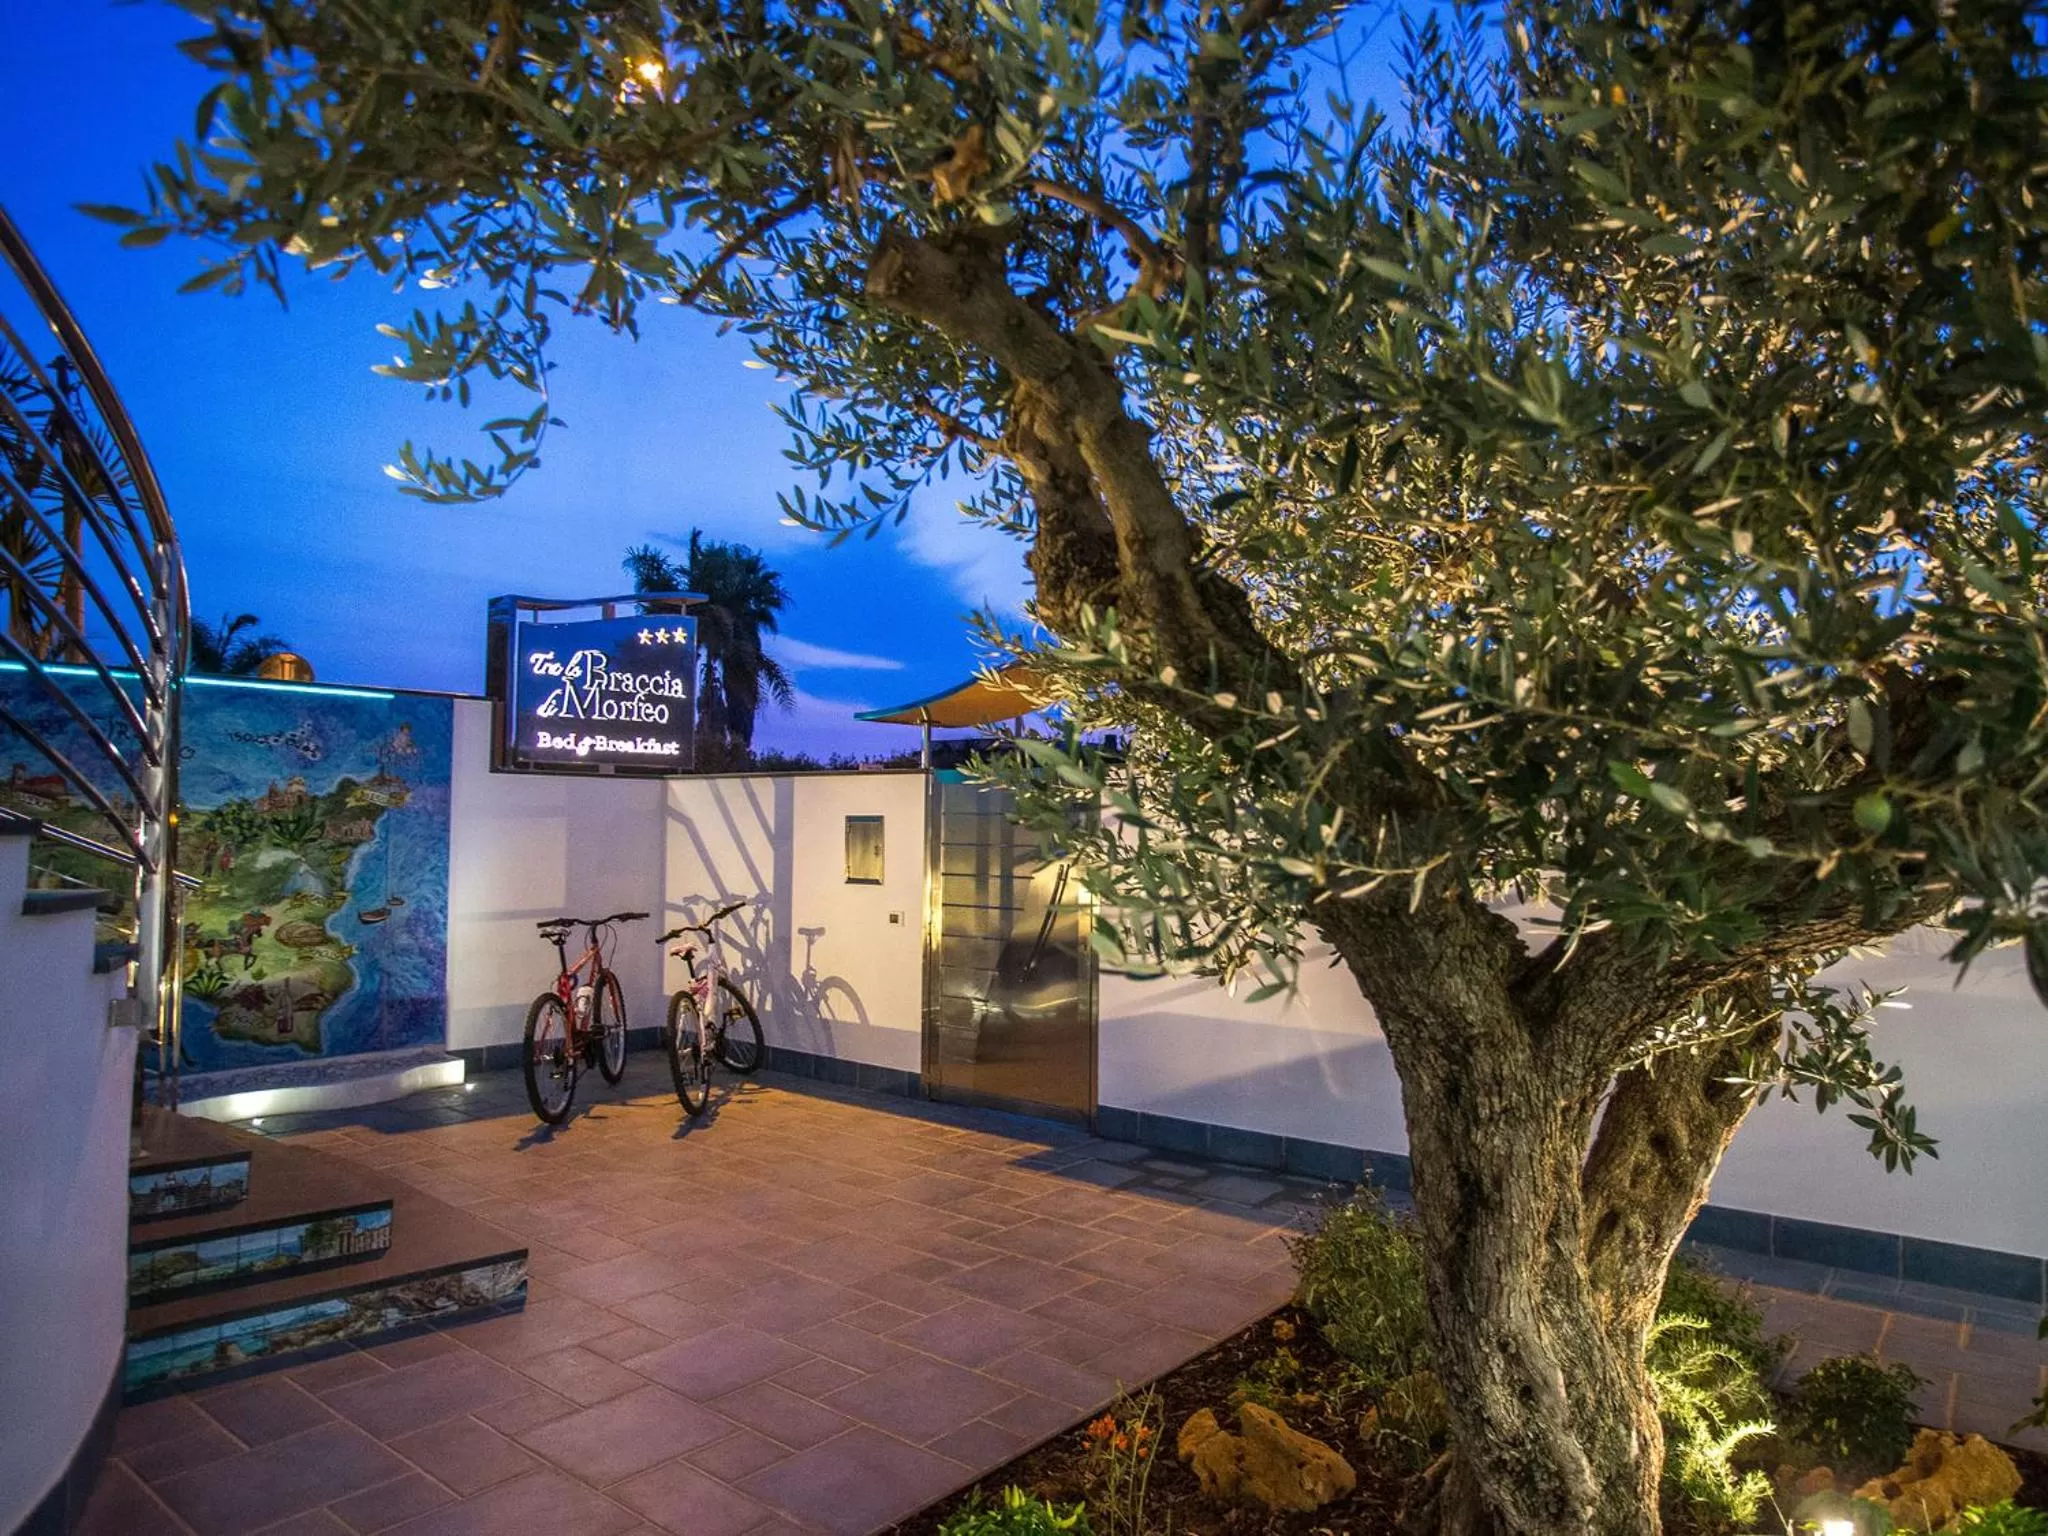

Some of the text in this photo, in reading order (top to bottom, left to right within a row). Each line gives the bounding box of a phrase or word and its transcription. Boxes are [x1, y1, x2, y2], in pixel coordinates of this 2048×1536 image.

[582, 649, 686, 698] Braccia
[559, 676, 669, 723] Morfeo
[537, 732, 576, 749] Bed
[594, 736, 680, 755] Breakfast
